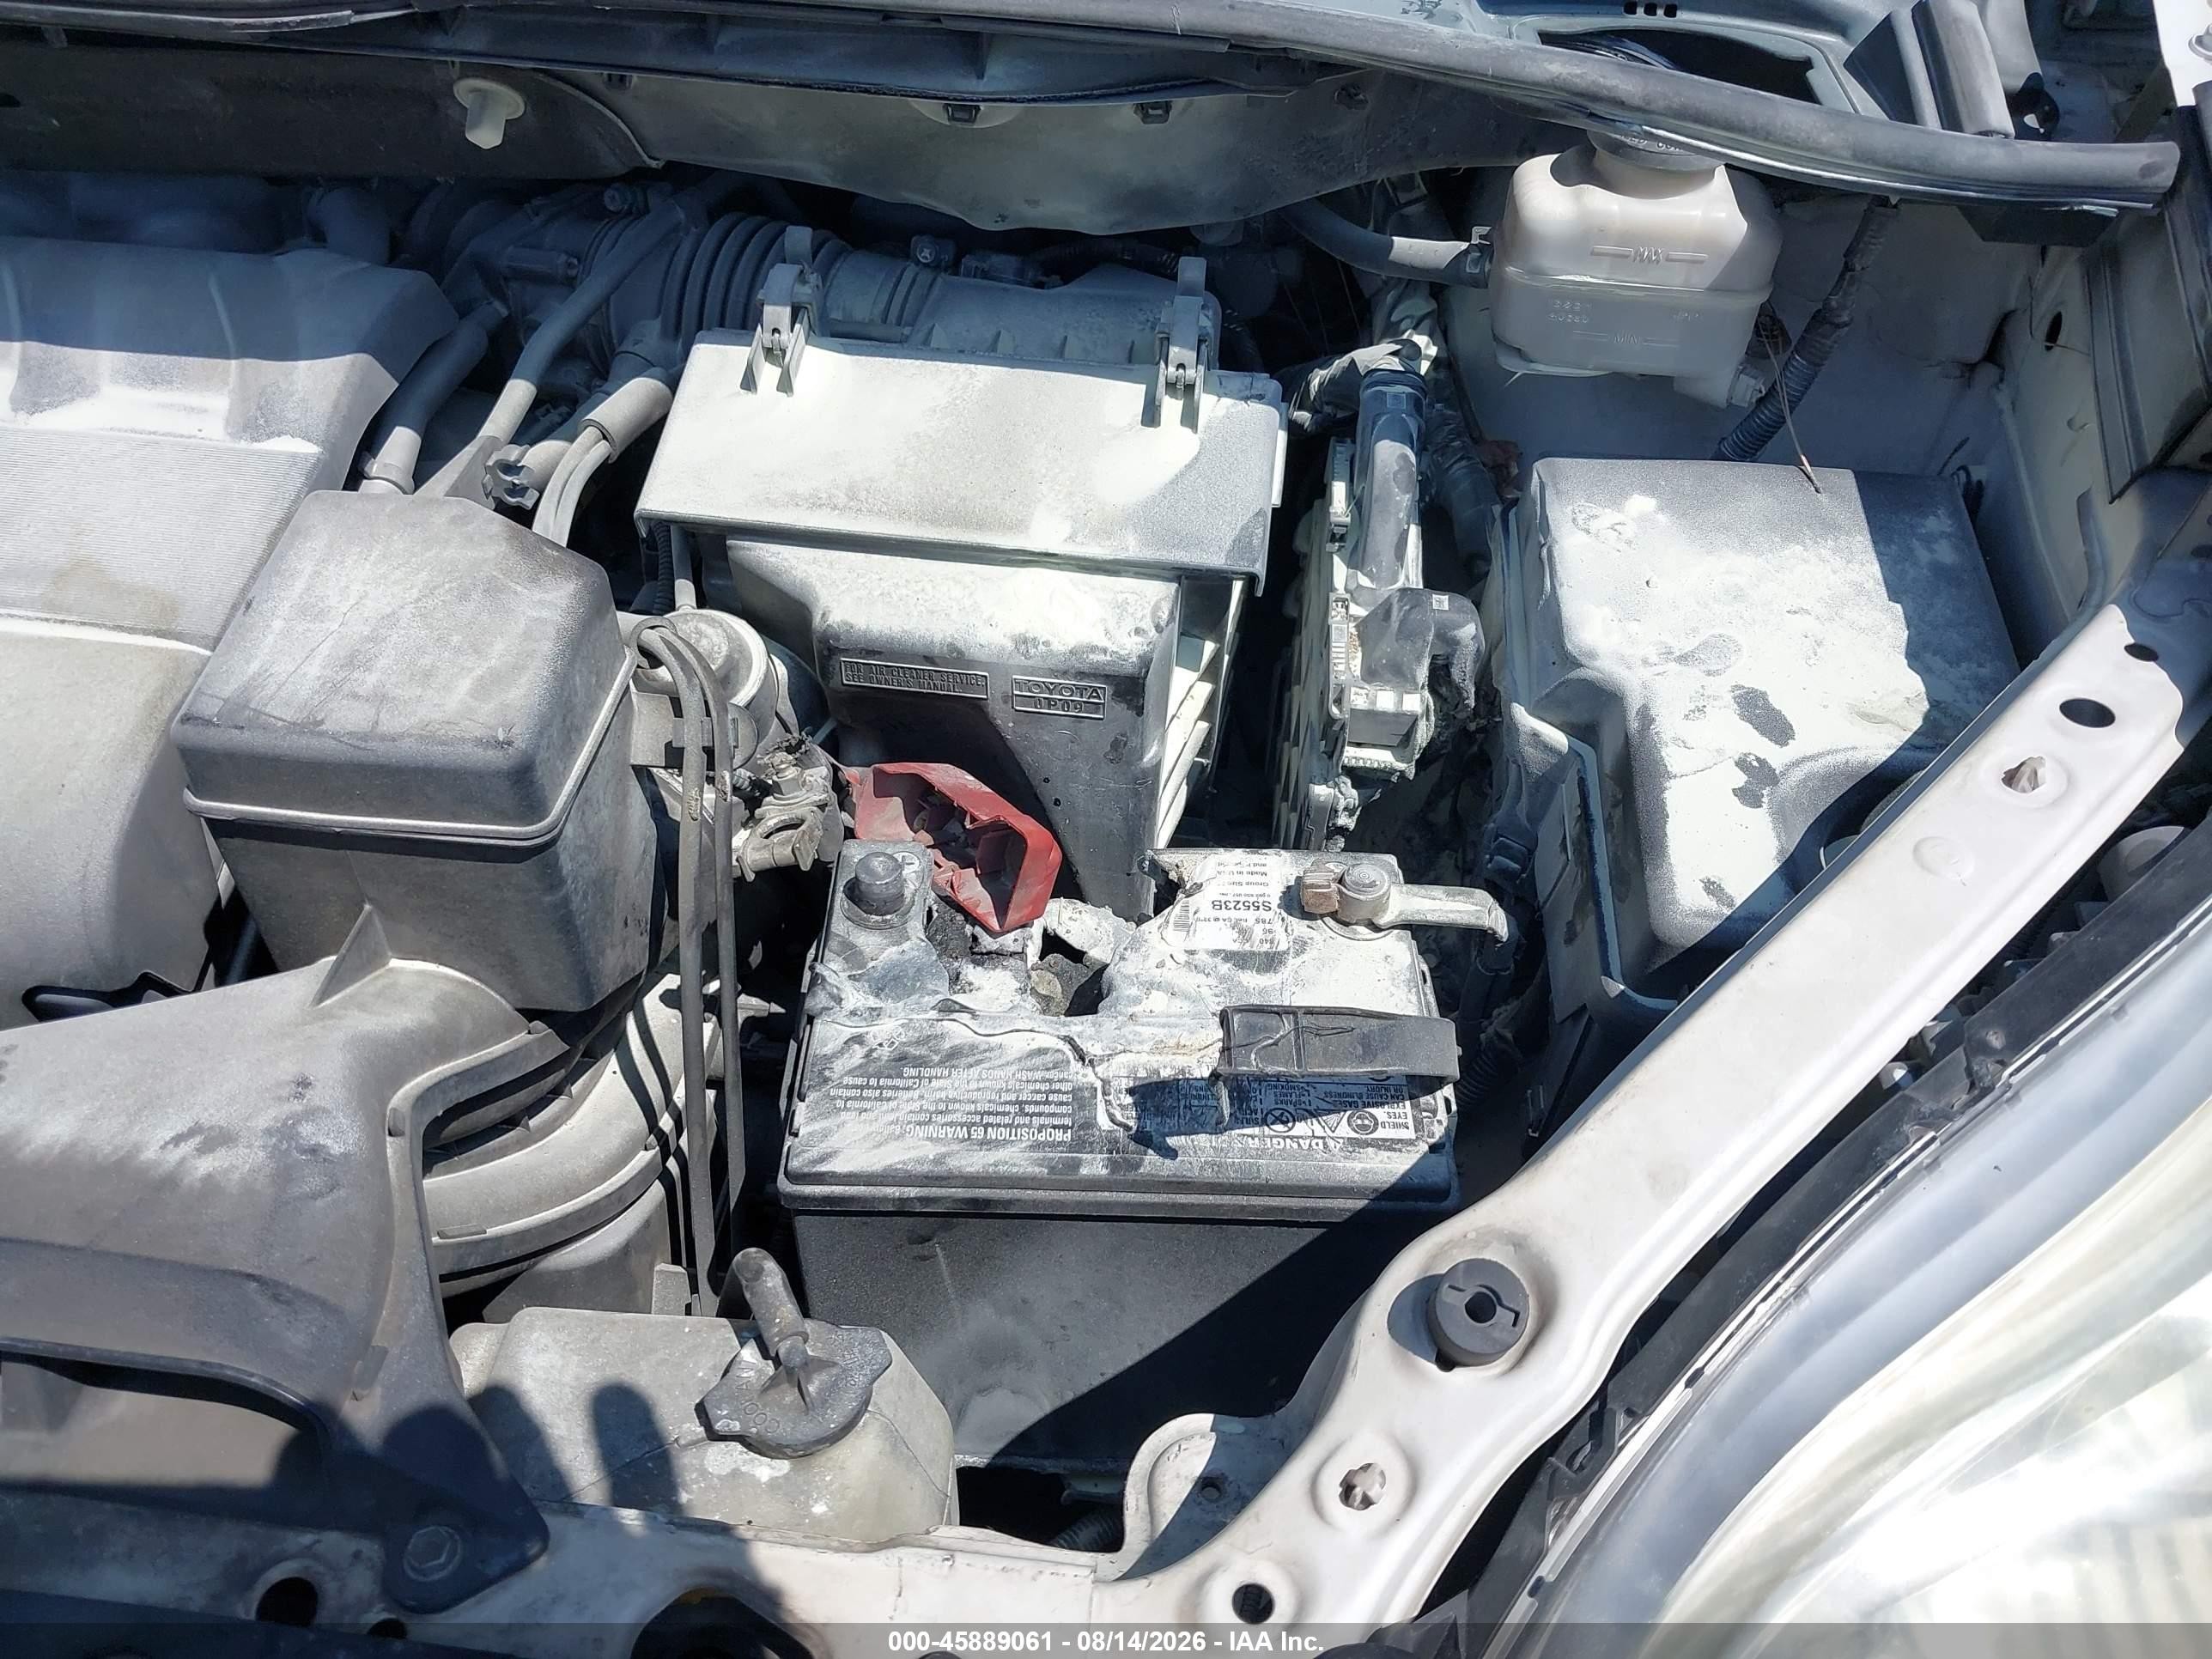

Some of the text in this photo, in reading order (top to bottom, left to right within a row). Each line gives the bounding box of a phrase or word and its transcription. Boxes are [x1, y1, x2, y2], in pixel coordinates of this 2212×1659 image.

[1633, 246, 1663, 264] MAX
[846, 663, 985, 686] FOR AIR CLEANER SERVICE.
[846, 672, 963, 692] SEE OWNER'S MANUAL.
[1016, 679, 1103, 702] TOYOTA
[1211, 899, 1273, 912] S5523B
[899, 1066, 949, 1077] HANDLING.
[842, 1076, 867, 1085] cause
[869, 1077, 878, 1086] to
[878, 1078, 919, 1088] California
[921, 1078, 929, 1088] of
[1007, 1080, 1050, 1091] chemicals
[1052, 1081, 1073, 1091] other
[1393, 1085, 1403, 1094] OR
[830, 1087, 860, 1097] contain
[862, 1089, 881, 1098] also
[1000, 1092, 1018, 1102] and
[1323, 1091, 1405, 1101] CAN CAUSE BLINDNESS
[1048, 1093, 1073, 1103] cause
[1273, 1098, 1302, 1107] SPARKS
[836, 1099, 845, 1109] to
[847, 1099, 887, 1110] California
[922, 1101, 936, 1111] the
[938, 1102, 946, 1111] to
[947, 1102, 975, 1111] known
[977, 1103, 1019, 1112] chemicals
[1361, 1100, 1407, 1110] EXPLOSIVE
[899, 1113, 930, 1122] contain
[933, 1113, 981, 1123] accessories
[983, 1115, 1012, 1125] related
[1014, 1115, 1030, 1125] and
[1382, 1110, 1407, 1120] EYES.
[1032, 1115, 1072, 1127] terminals
[1380, 1121, 1410, 1131] SHIELD
[902, 1123, 969, 1139] WARNING:
[970, 1126, 985, 1139] 65
[987, 1126, 1072, 1141] PROPOSITION
[1247, 1137, 1324, 1150] DANGER
